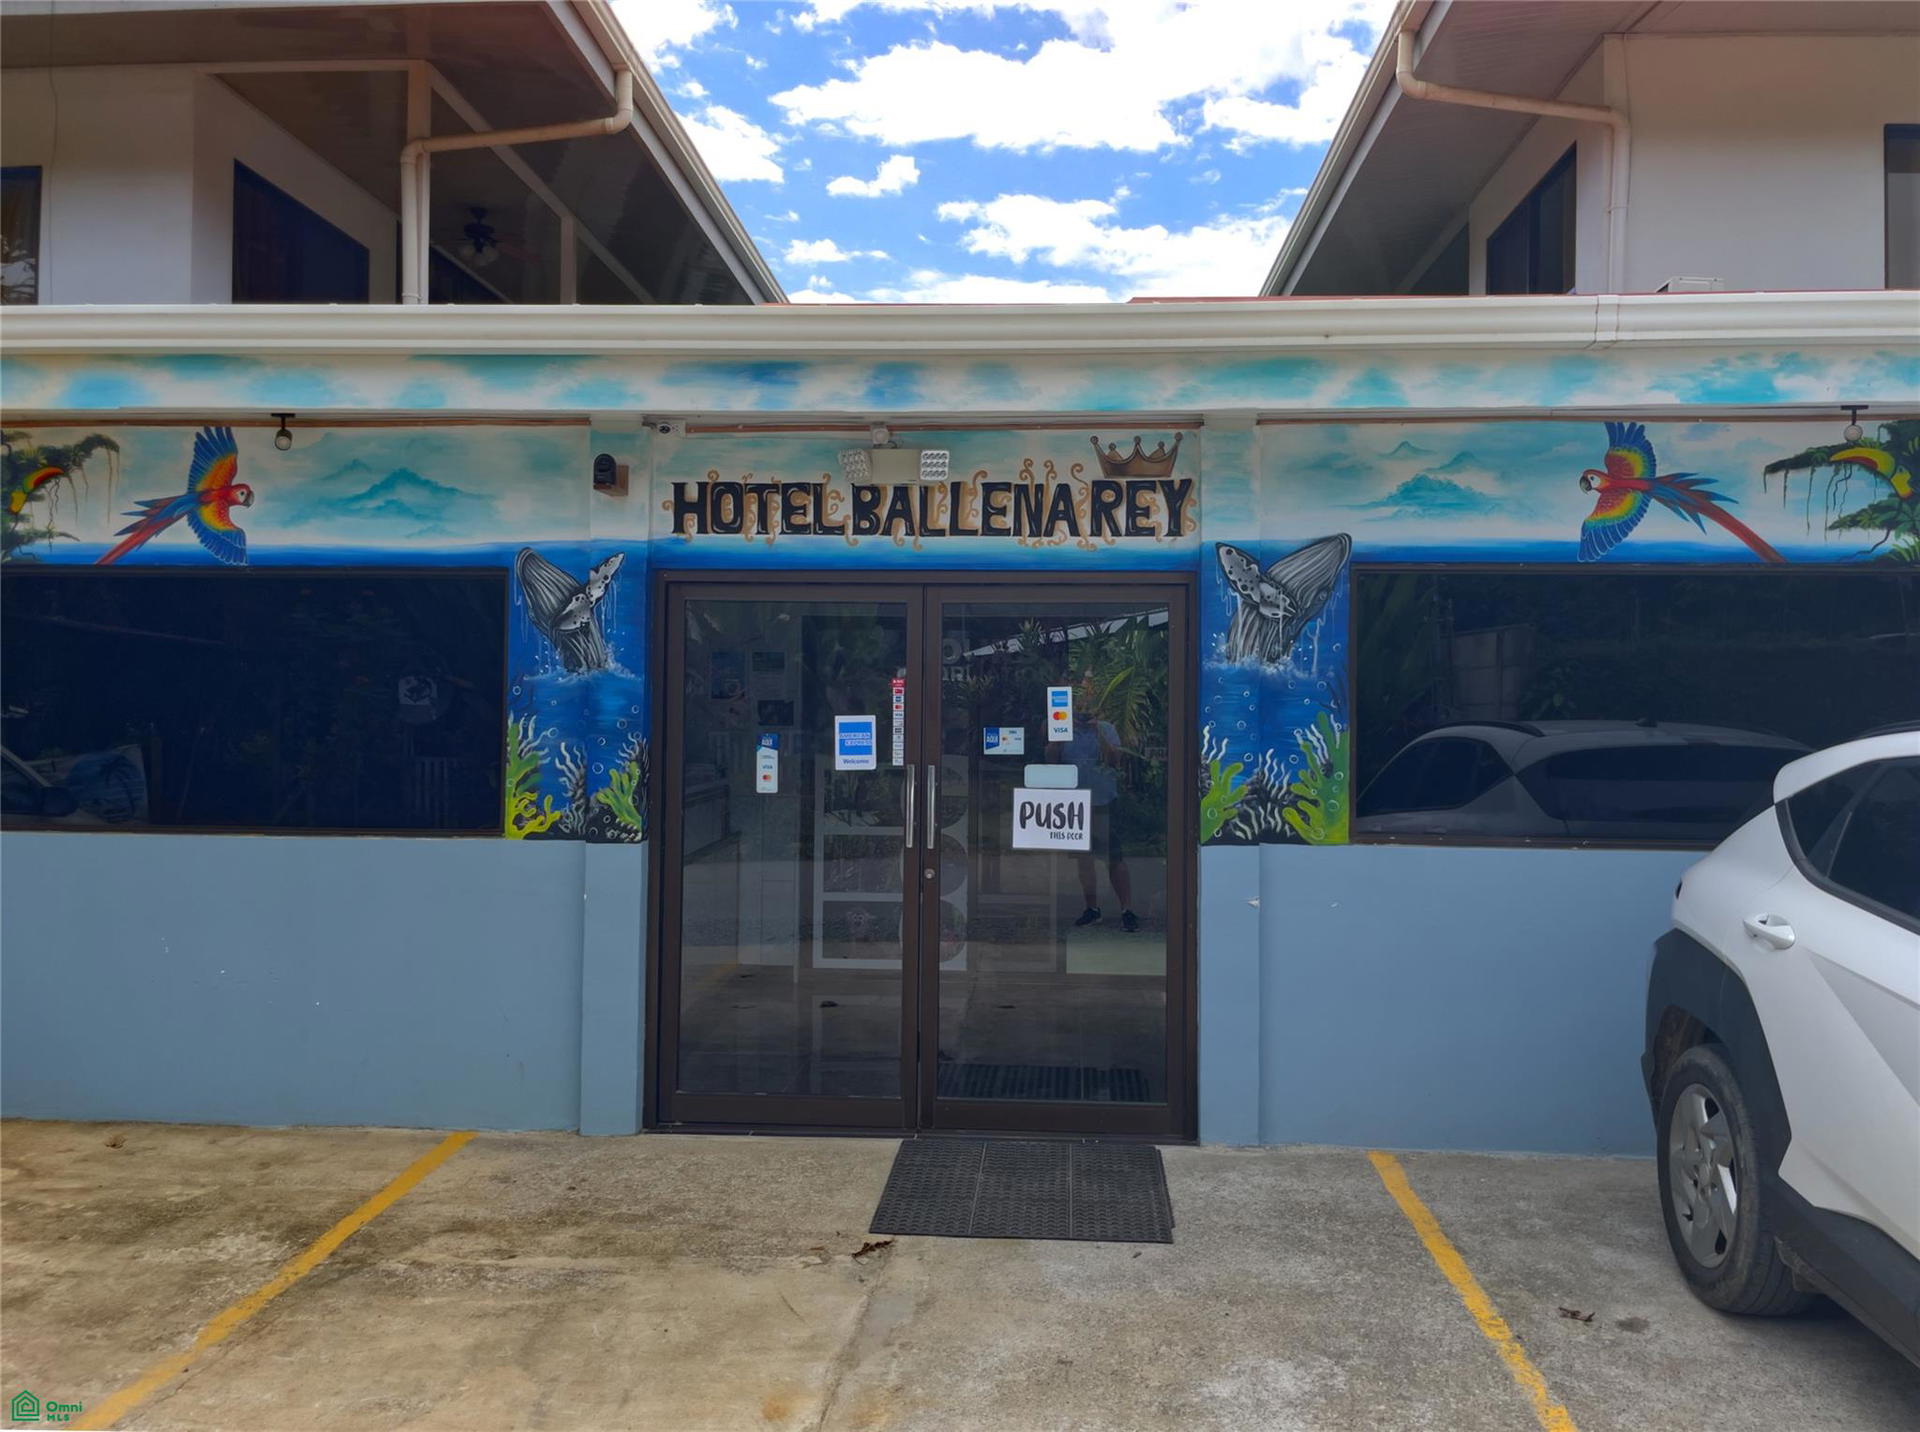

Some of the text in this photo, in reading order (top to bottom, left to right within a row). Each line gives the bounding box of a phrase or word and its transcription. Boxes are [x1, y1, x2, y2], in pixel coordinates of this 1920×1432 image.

[671, 478, 1194, 538] HOTEL BALLENA REY
[1019, 801, 1085, 831] PUSH
[1049, 831, 1084, 841] THIS DOOR
